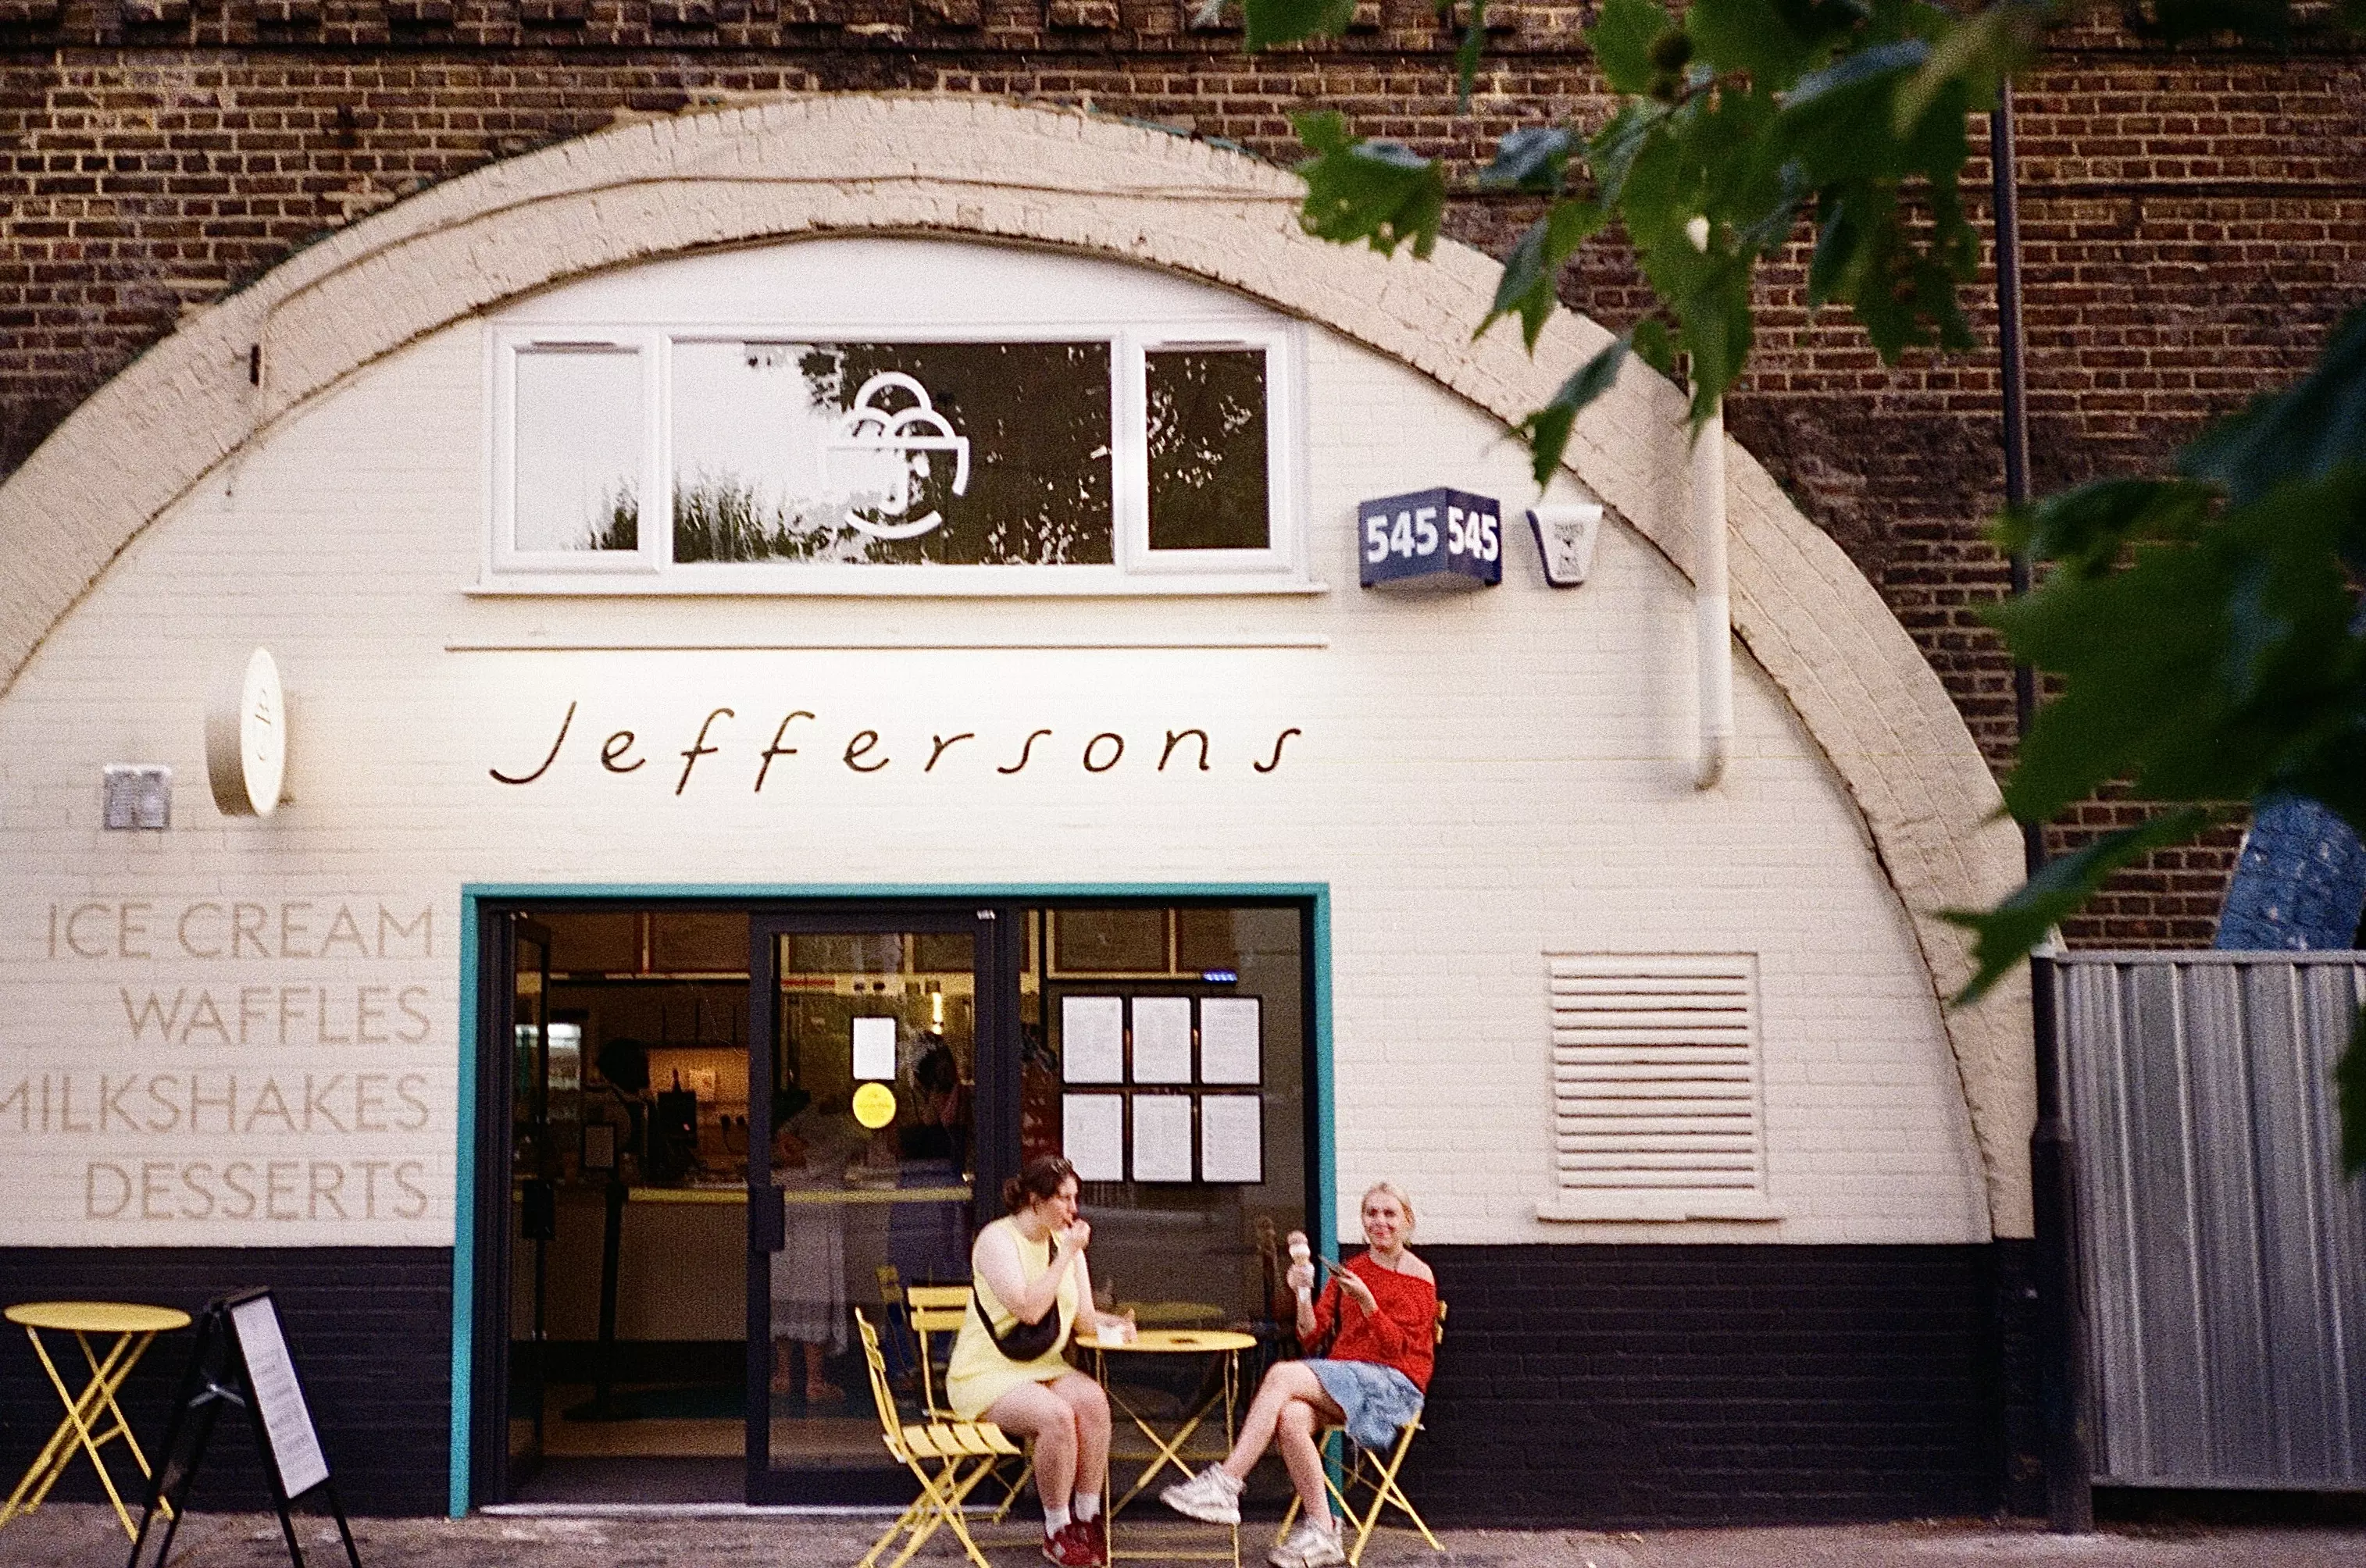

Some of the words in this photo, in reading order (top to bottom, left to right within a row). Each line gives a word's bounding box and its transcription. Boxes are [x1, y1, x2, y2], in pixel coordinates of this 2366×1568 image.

[1366, 505, 1440, 563] 545
[1447, 506, 1500, 562] 545
[490, 700, 1302, 795] Jeffersons
[48, 903, 152, 959] ICE
[178, 903, 434, 959] CREAM
[120, 985, 430, 1045] WAFFLES
[84, 1161, 430, 1221] DESSERTS
